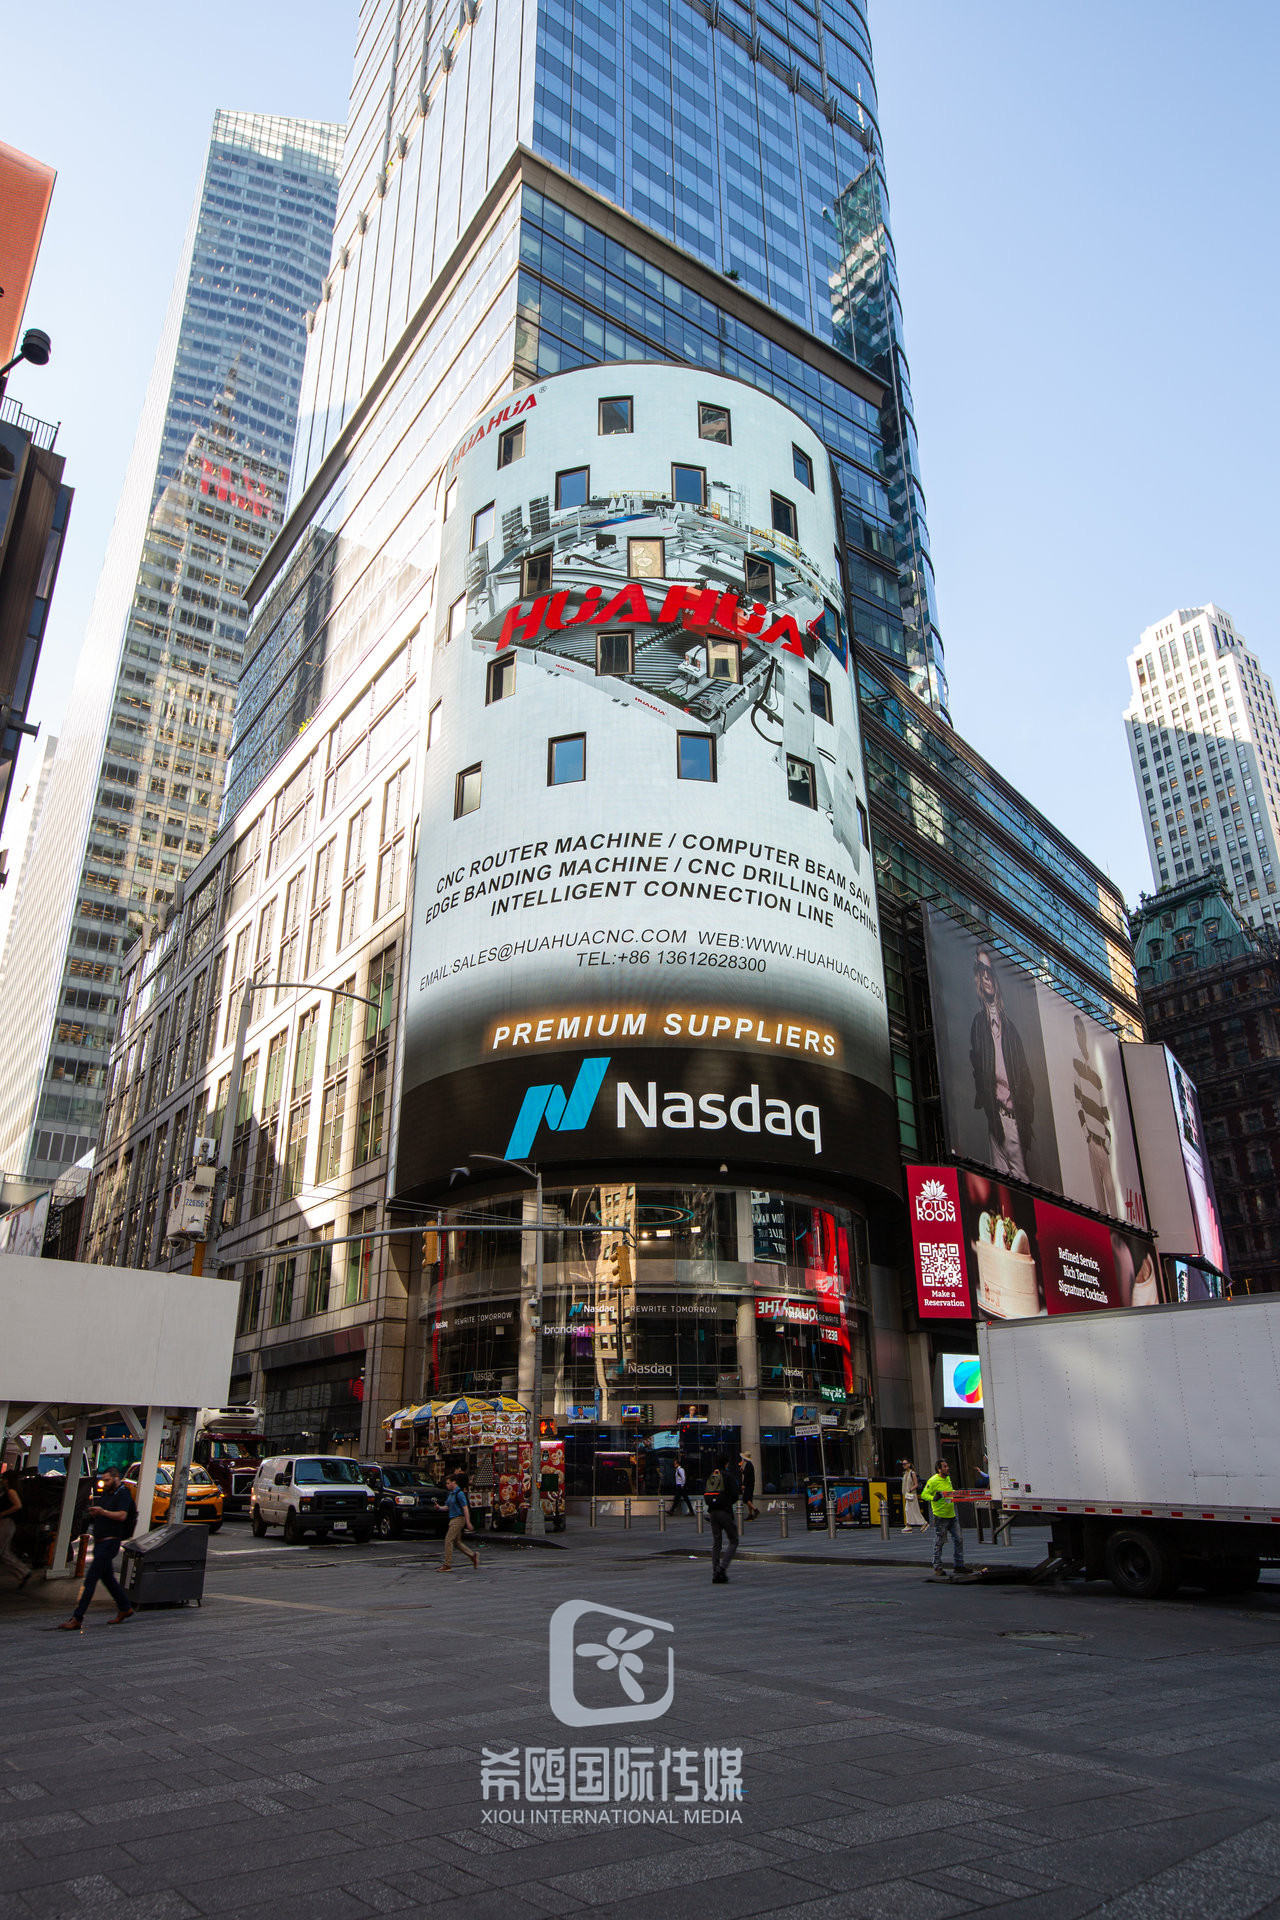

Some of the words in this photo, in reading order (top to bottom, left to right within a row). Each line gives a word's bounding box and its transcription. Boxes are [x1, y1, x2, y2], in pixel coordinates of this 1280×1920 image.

[436, 867, 465, 894] CNC
[469, 841, 549, 877] ROUTER
[554, 832, 663, 854] MACHINE
[668, 832, 677, 849] /
[682, 834, 800, 871] COMPUTER
[804, 858, 846, 890] BEAM
[849, 881, 871, 909] SAW
[425, 891, 461, 925] EDGE
[463, 864, 552, 903] BANDING
[559, 856, 668, 878] MACHINE
[673, 857, 682, 873] /
[688, 859, 735, 877] CNC
[743, 864, 829, 902] DRILLING
[833, 892, 878, 940] MACHINE
[491, 881, 637, 917] INTELLIGENT
[644, 880, 791, 913] CONNECTION
[797, 901, 834, 928] LINE
[577, 950, 650, 967] TEL:+86
[657, 950, 767, 973] 13612628300
[492, 1013, 647, 1049] PREMIUM
[663, 1013, 836, 1056] SUPPLIERS
[616, 1081, 822, 1155] Nasdaq
[915, 1199, 955, 1213] LOTUS
[916, 1210, 956, 1222] ROOM
[1058, 1247, 1079, 1265] Refined
[1079, 1254, 1100, 1273] Service,
[1062, 1264, 1076, 1280] Rich
[1076, 1268, 1100, 1288] Textures,
[924, 1298, 965, 1307] Reservation
[931, 1290, 951, 1298] Make
[1058, 1280, 1085, 1297] Signature
[1085, 1287, 1108, 1304] Cocktails
[583, 1304, 615, 1315] Nasdaq
[631, 1305, 667, 1313] REWRITE
[671, 1305, 718, 1314] TOMORROW
[628, 1362, 672, 1376] Nasdaq
[837, 1487, 863, 1515] AMAZE
